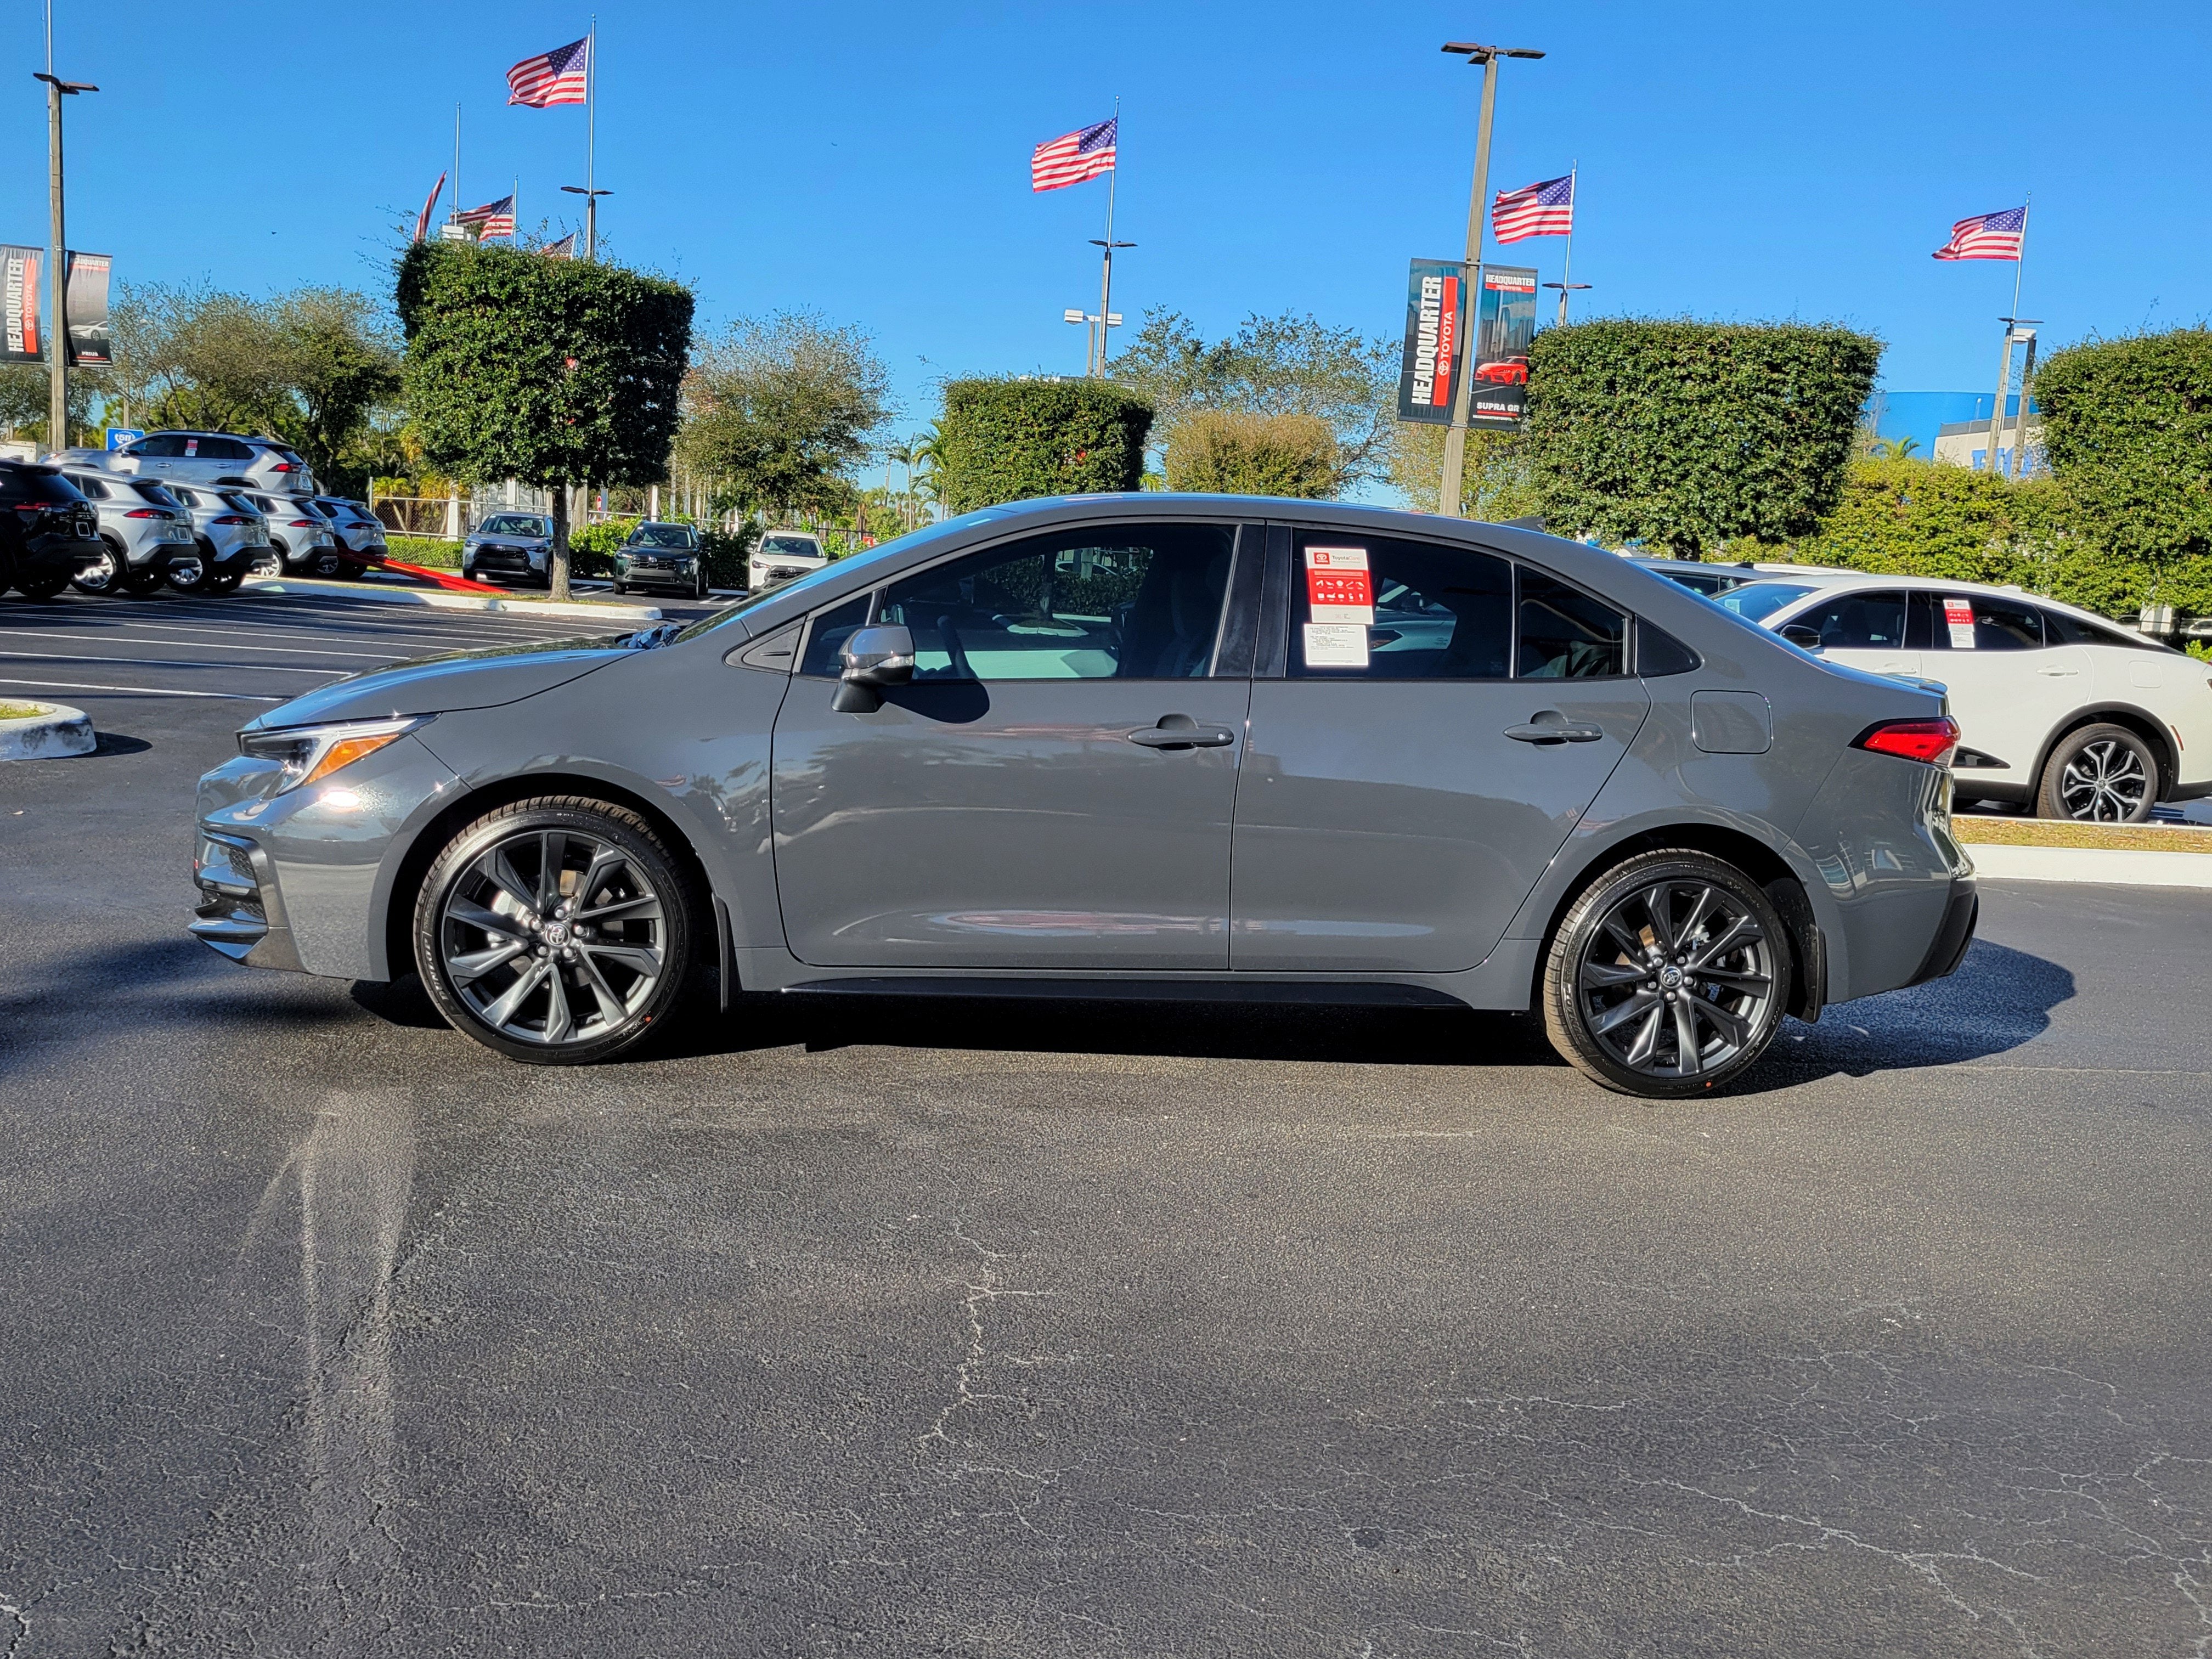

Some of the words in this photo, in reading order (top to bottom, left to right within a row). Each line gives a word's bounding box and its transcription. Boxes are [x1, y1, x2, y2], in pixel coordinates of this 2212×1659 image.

[25, 283, 33, 319] TOYOTA
[1485, 274, 1535, 287] HEADQUARTER
[6, 258, 25, 353] HEADQUARTER
[1411, 276, 1442, 405] HEADQUARTER
[1440, 311, 1454, 360] TOYOTA
[1476, 402, 1506, 411] SUPRA
[1507, 404, 1520, 412] GR
[424, 938, 449, 1001] DUNLOP
